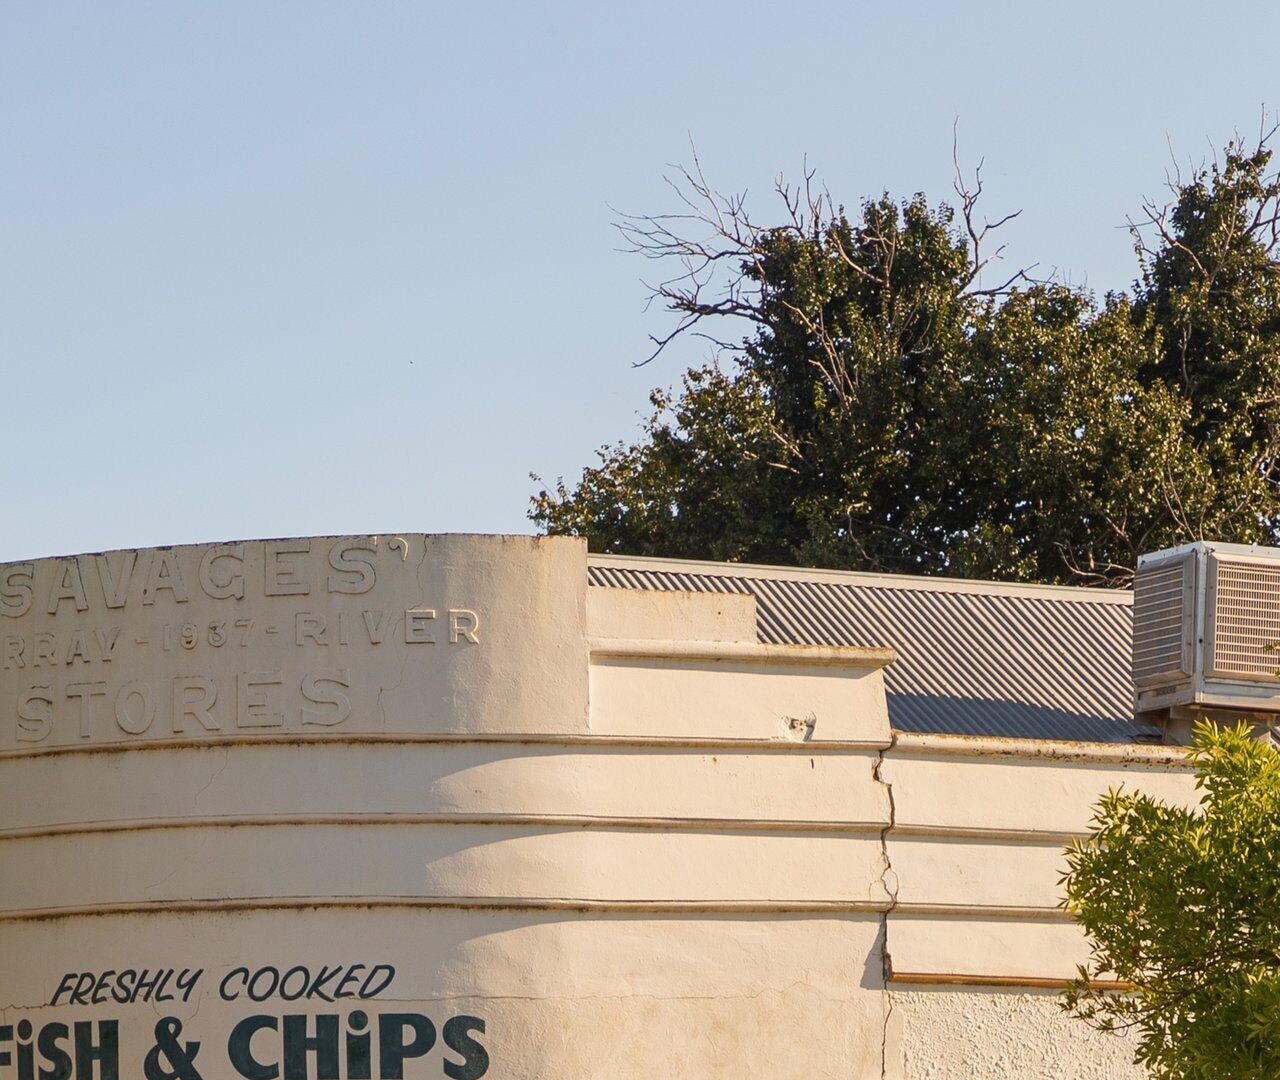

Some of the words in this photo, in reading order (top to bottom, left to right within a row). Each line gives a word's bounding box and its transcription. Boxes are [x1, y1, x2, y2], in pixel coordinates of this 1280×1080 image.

[294, 608, 480, 648] RIVER
[15, 666, 354, 742] STORES
[50, 967, 204, 1007] FRESHLY
[220, 964, 396, 1003] COOKED
